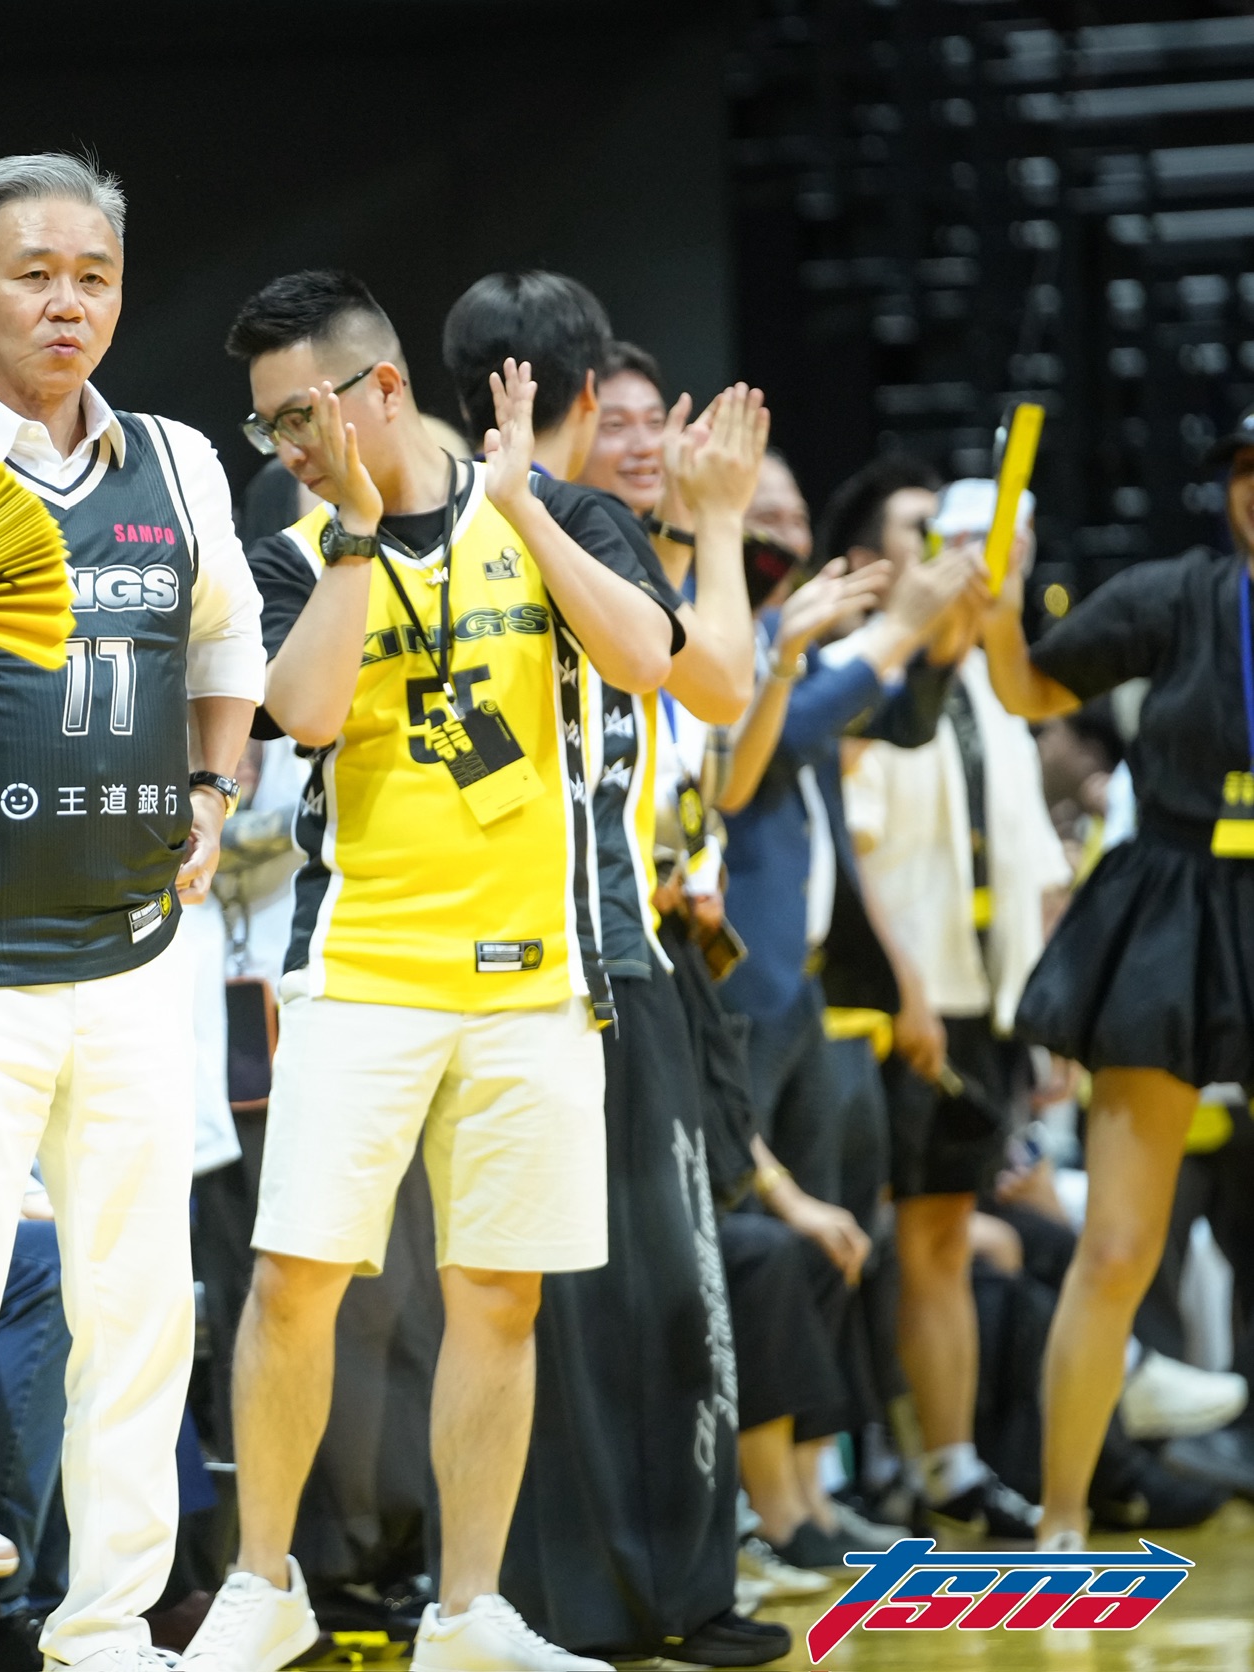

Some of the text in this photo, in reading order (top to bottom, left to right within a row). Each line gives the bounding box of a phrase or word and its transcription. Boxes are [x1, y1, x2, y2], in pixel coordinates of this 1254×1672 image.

[112, 523, 176, 545] SAMPO
[64, 563, 180, 613] NGS
[442, 718, 474, 753] VIP
[56, 783, 178, 816] 王道銀行
